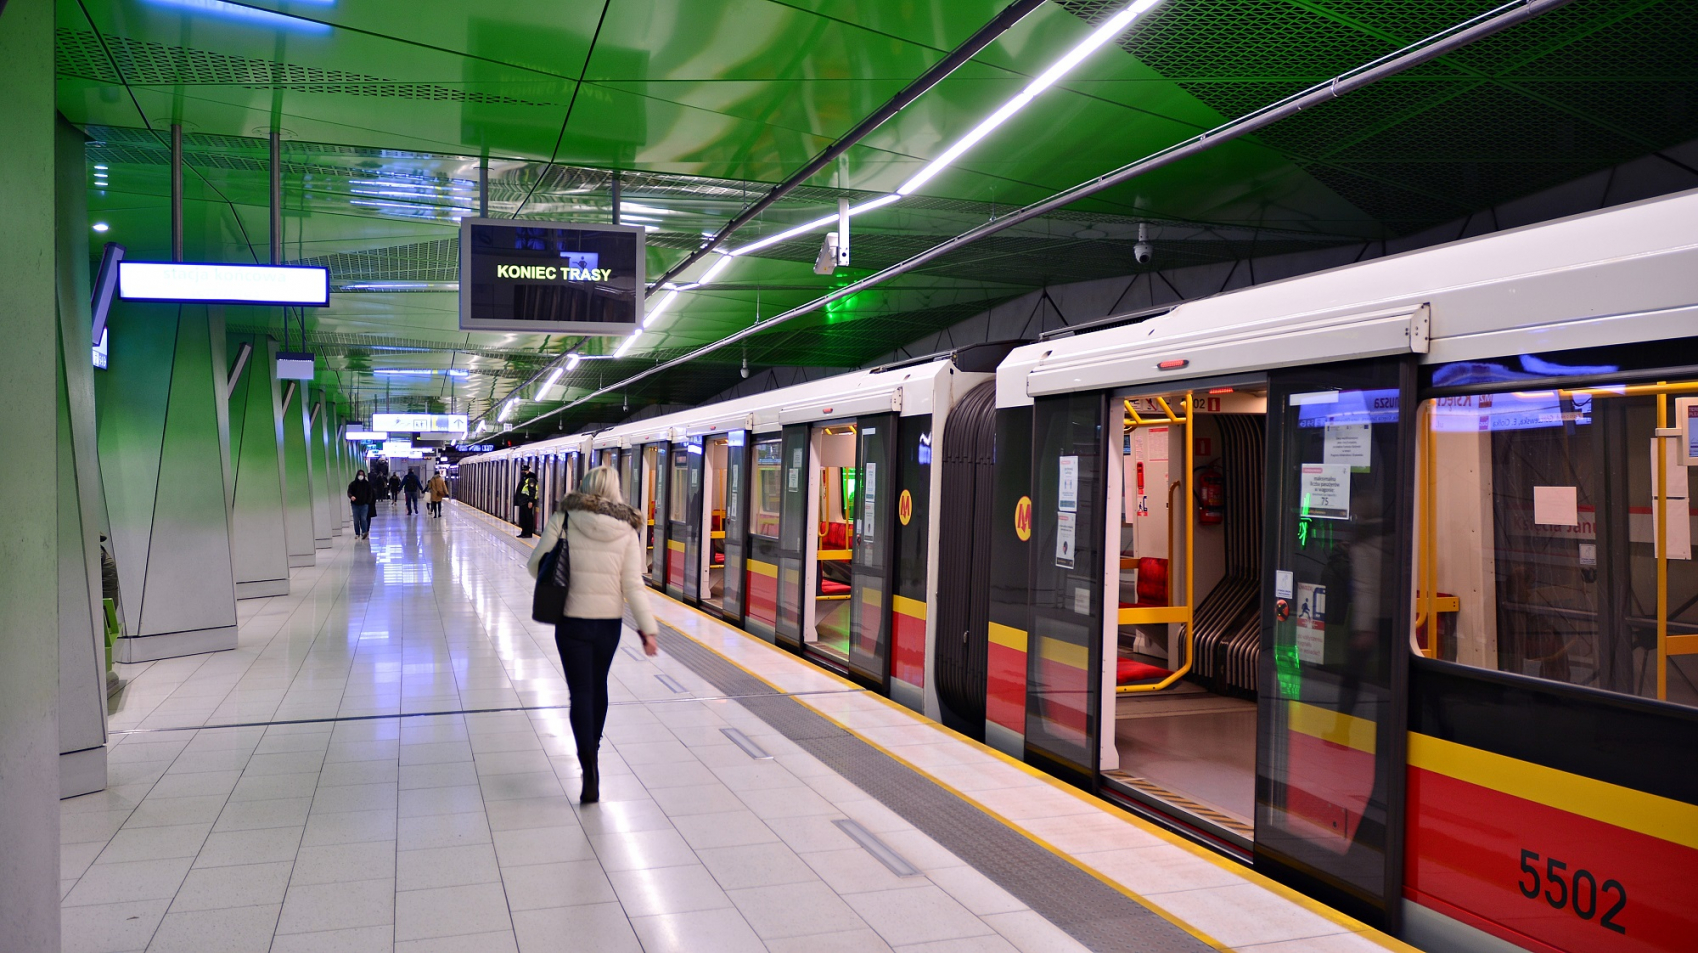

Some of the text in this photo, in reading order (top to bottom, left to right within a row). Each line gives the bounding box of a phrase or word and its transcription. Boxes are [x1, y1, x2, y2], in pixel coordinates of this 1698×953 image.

[163, 267, 209, 284] stacja
[497, 264, 611, 282] KONIEC TRASY
[1519, 848, 1627, 935] 5502
